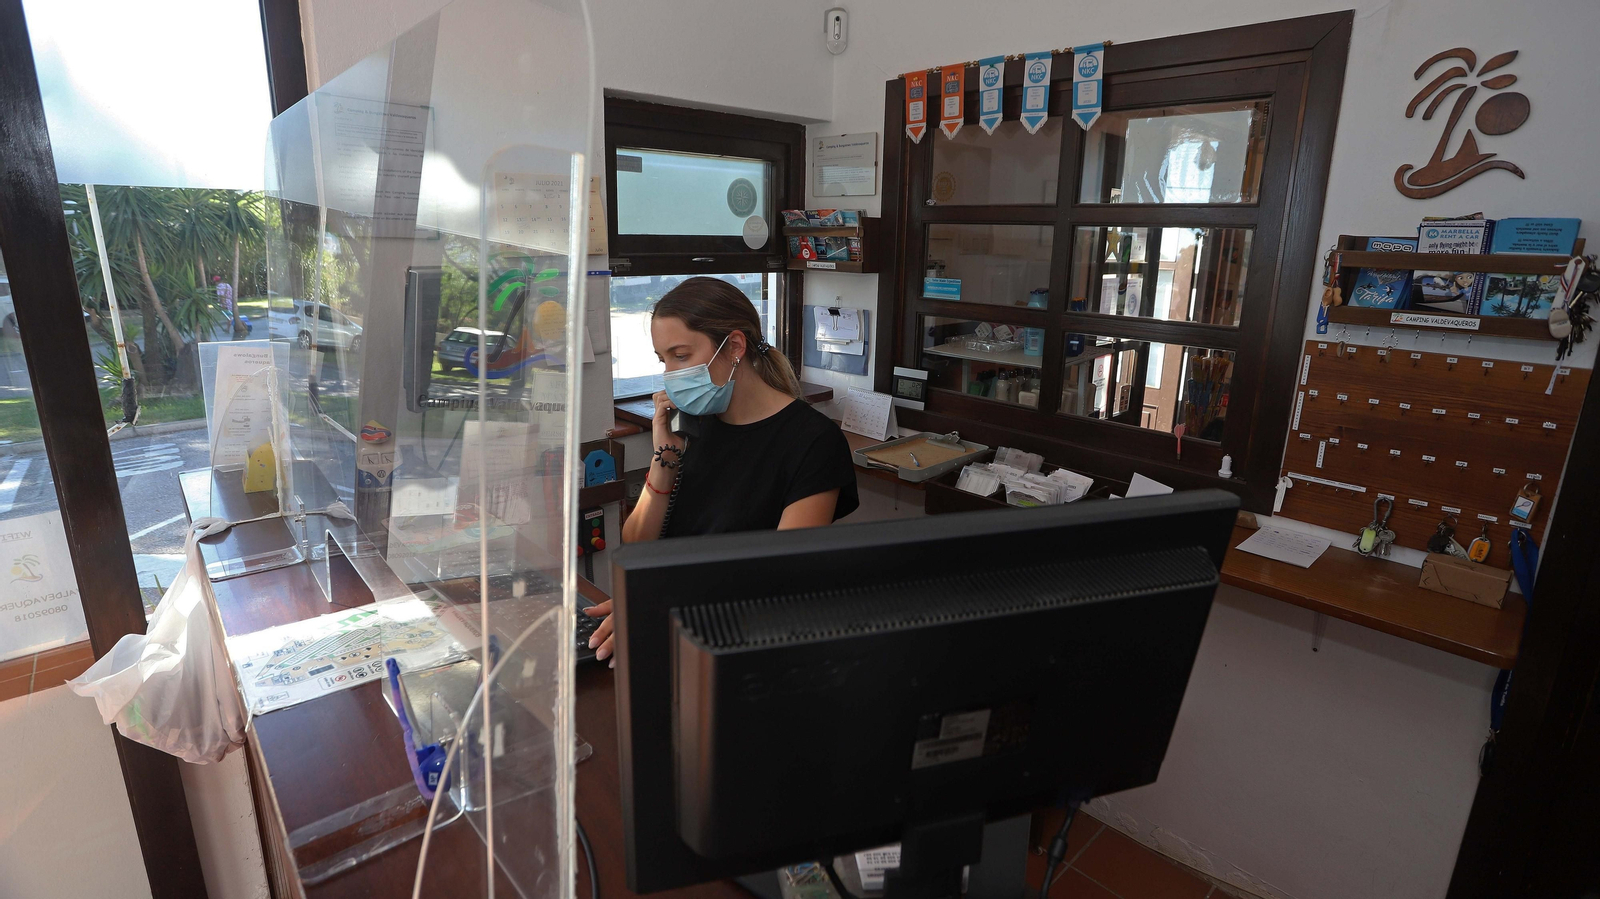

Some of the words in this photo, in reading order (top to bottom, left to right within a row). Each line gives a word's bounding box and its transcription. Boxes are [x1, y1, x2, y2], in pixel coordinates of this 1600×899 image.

[1372, 241, 1413, 252] mapa
[1355, 287, 1394, 305] Tarifa
[1431, 318, 1477, 327] VALDEVAQUEROS
[586, 511, 603, 519] ENTRADA
